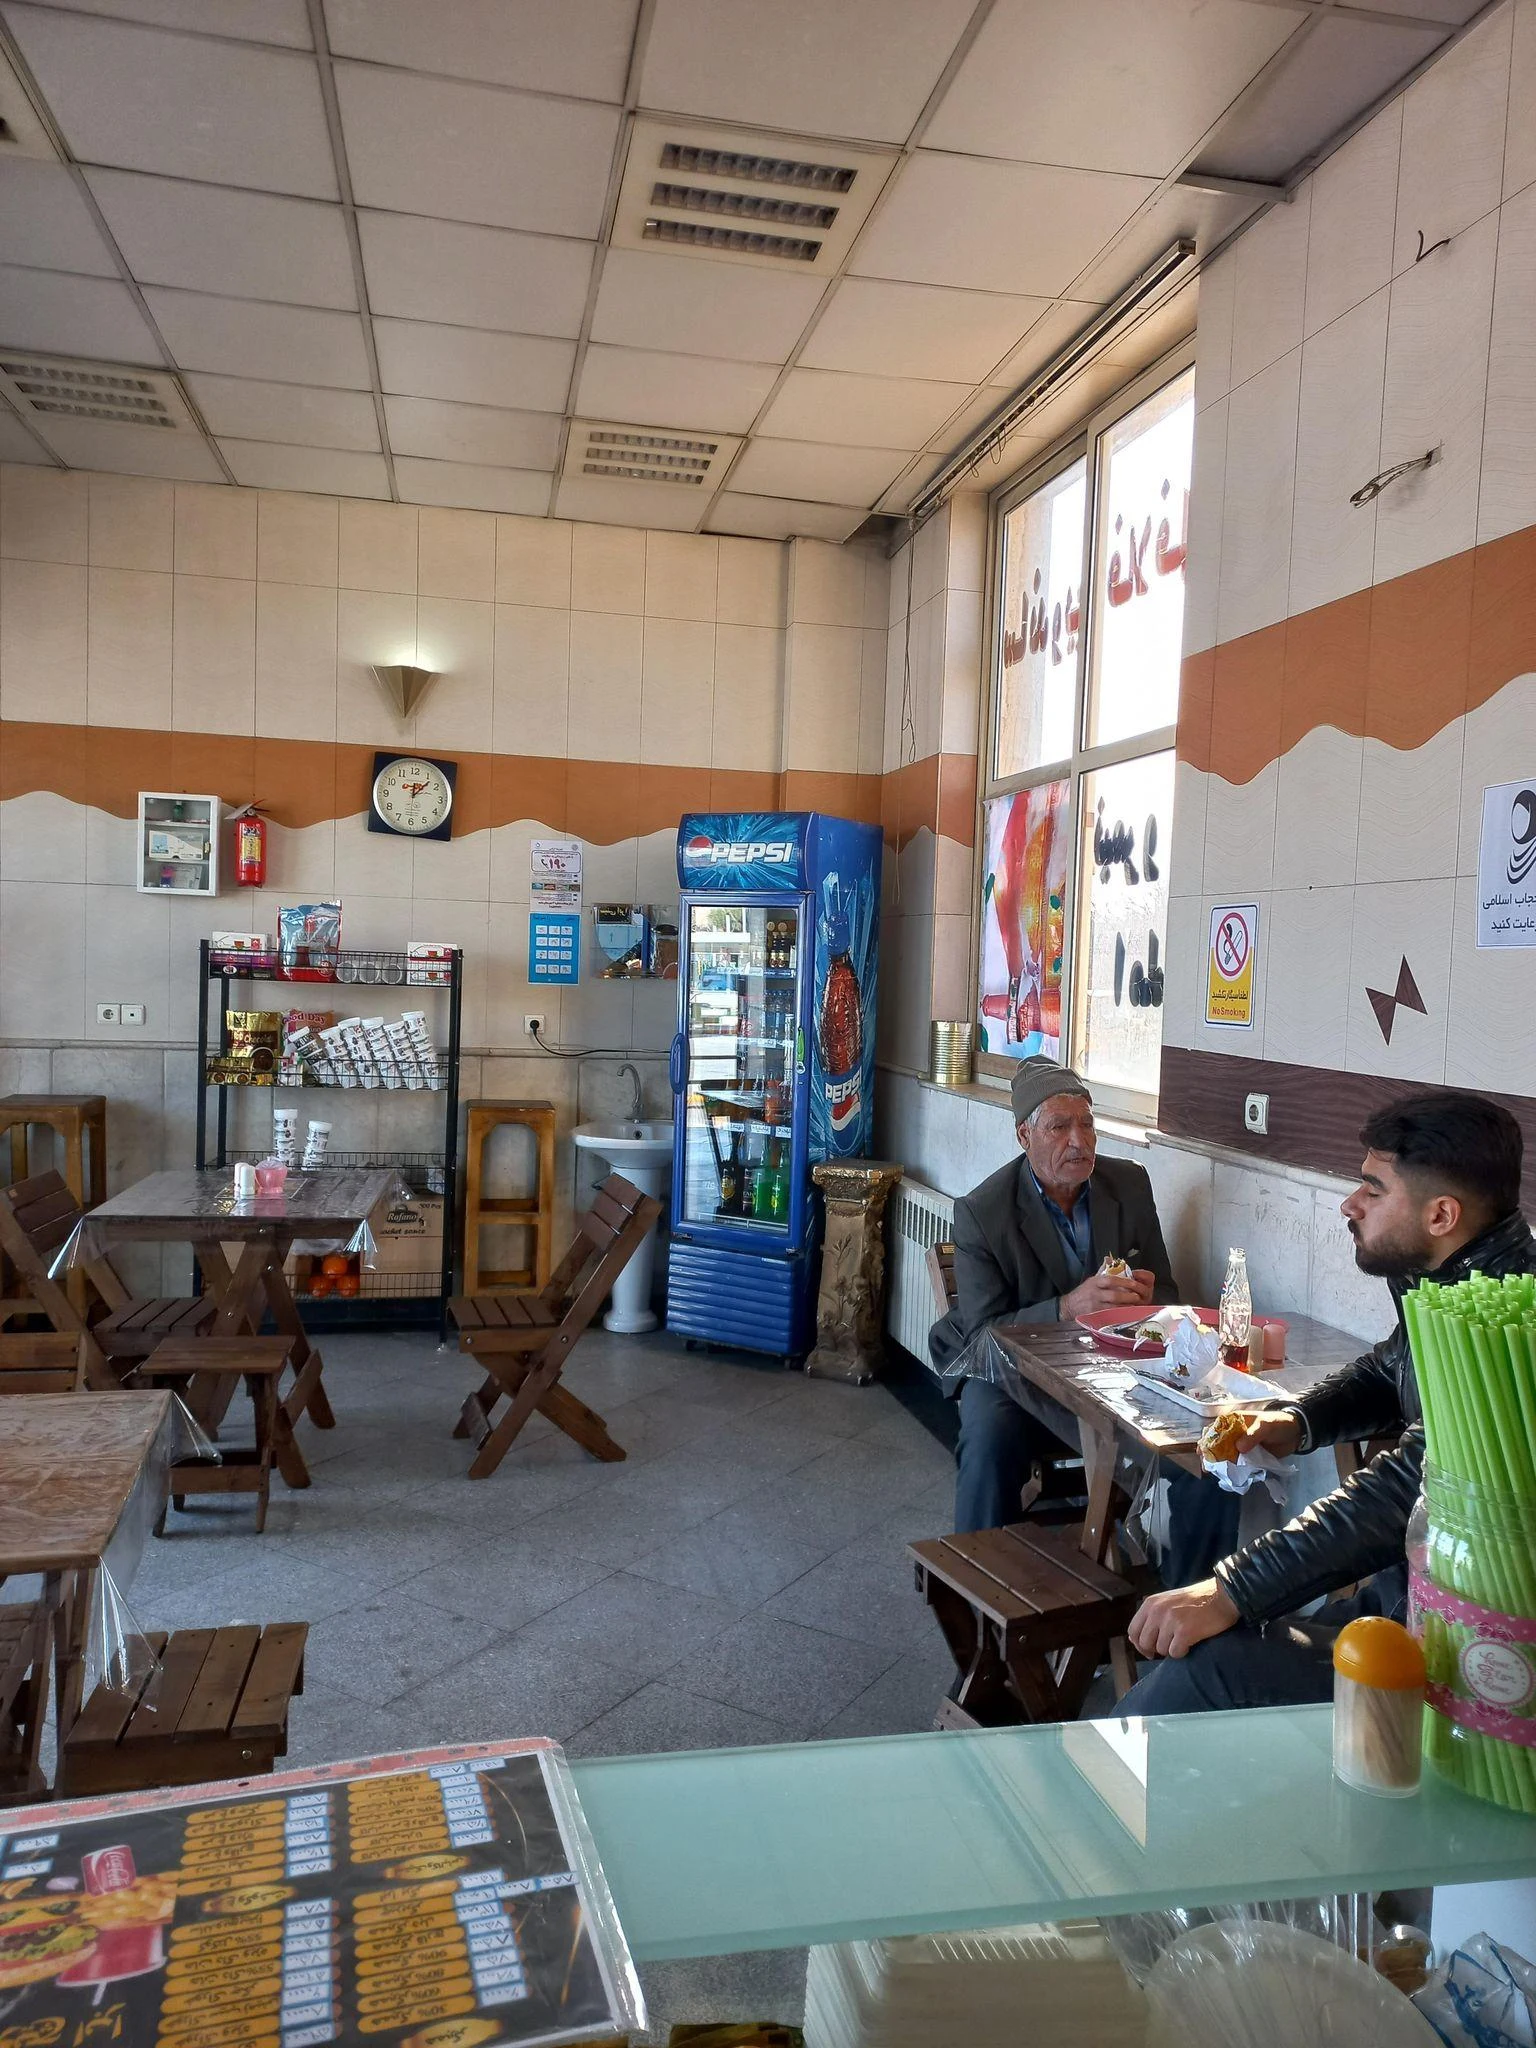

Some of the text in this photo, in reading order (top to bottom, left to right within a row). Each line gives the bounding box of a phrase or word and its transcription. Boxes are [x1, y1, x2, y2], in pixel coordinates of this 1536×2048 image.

[398, 769, 406, 778] 11
[410, 767, 420, 776] 12
[426, 772, 430, 780] 1
[387, 778, 396, 786] 10
[433, 782, 440, 791] 2
[382, 789, 389, 798] 9
[437, 796, 443, 804] 3
[386, 802, 393, 810] 8
[396, 812, 402, 821] 7
[432, 808, 438, 816] 4
[408, 817, 414, 826] 6
[421, 816, 428, 824] 5
[710, 842, 794, 864] PEPSI
[549, 858, 566, 869] ۱۹۰
[1482, 893, 1512, 910] اسلامی
[1491, 917, 1511, 933] کنید
[1212, 1006, 1246, 1019] No Smoking
[308, 1013, 326, 1025] Day
[825, 1065, 862, 1104] PEPSI
